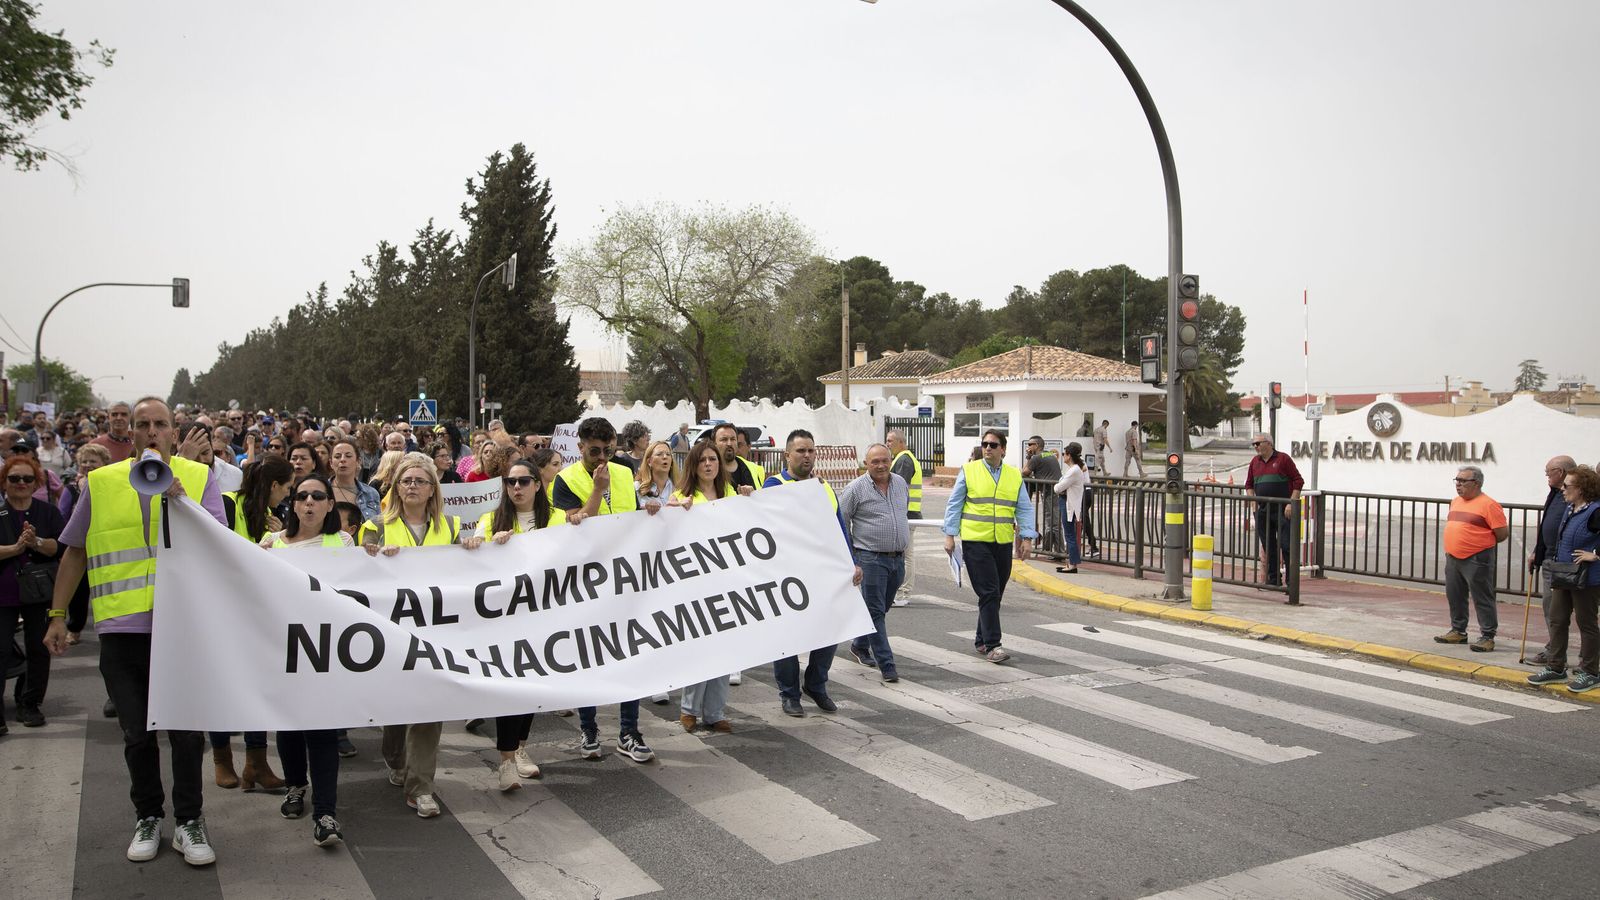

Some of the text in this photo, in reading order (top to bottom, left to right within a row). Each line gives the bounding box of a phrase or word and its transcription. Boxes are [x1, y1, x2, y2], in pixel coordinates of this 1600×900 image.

[1291, 441, 1328, 459] BAE
[1390, 441, 1411, 460] DE
[1416, 441, 1496, 462] ARMILLA
[285, 623, 385, 672] NO
[465, 576, 809, 677] HACINAMIENTO
[390, 586, 459, 627] AL
[474, 527, 776, 618] CAMPAMENTO
